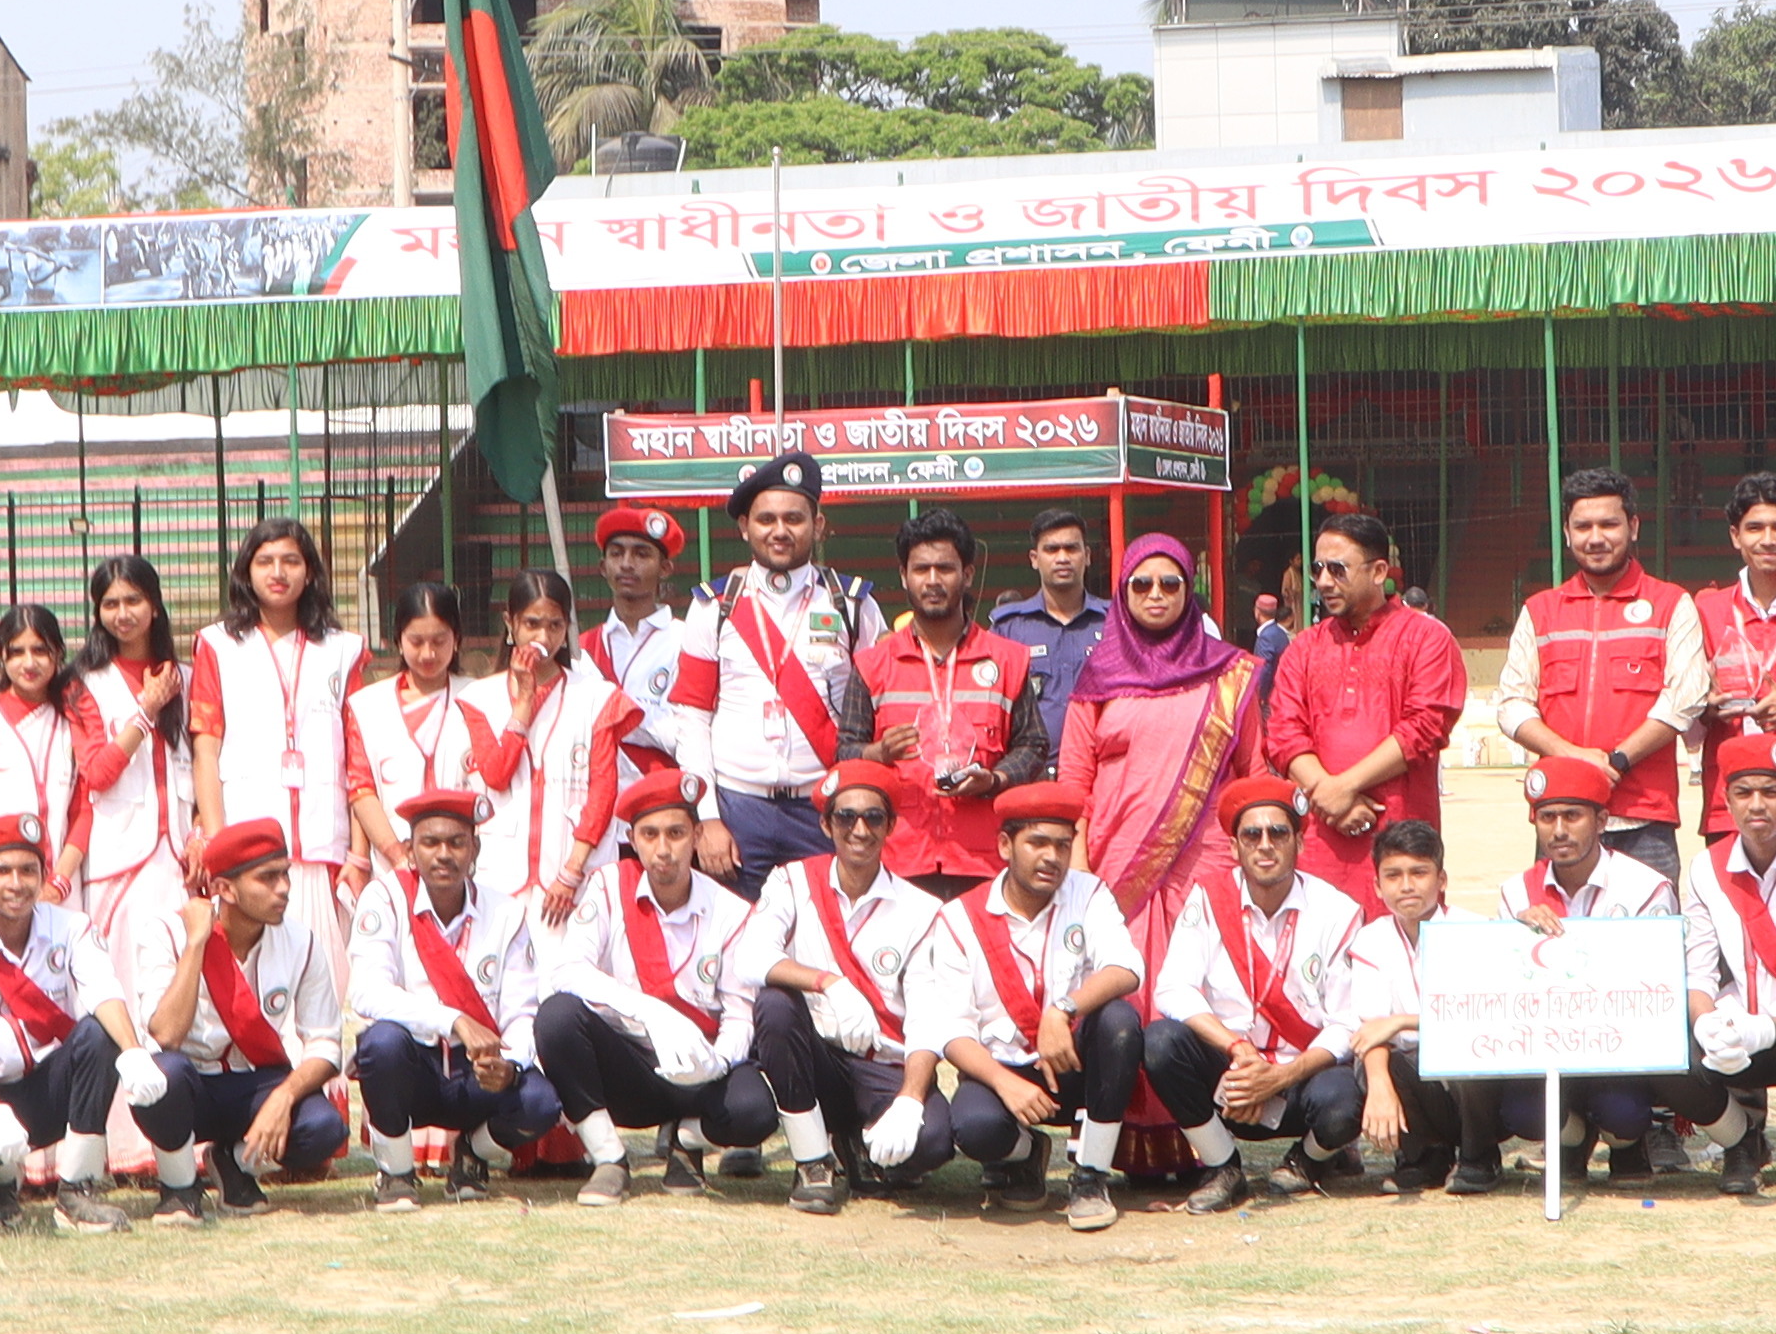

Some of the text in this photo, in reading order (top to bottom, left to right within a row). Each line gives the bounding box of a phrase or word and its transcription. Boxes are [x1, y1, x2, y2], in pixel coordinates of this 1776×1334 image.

[390, 221, 573, 259] মন
[595, 200, 895, 253] স্বাধীনতা
[930, 204, 985, 234] ও
[1022, 175, 1267, 231] জাতীয়
[1293, 166, 1499, 216] দিবস
[841, 249, 952, 271] জেলা
[1164, 226, 1279, 254] ফেনী
[628, 407, 1099, 458] মহান স্বাধীনতা ও জাতীয় দিবস ২০২৬
[906, 454, 958, 482] ফেনী
[1428, 992, 1508, 1022] বাংলাদেশ
[1513, 992, 1541, 1020] রেড
[1603, 980, 1674, 1019] সোসাইটি
[1471, 1023, 1624, 1059] ফেনী ইউনিট
